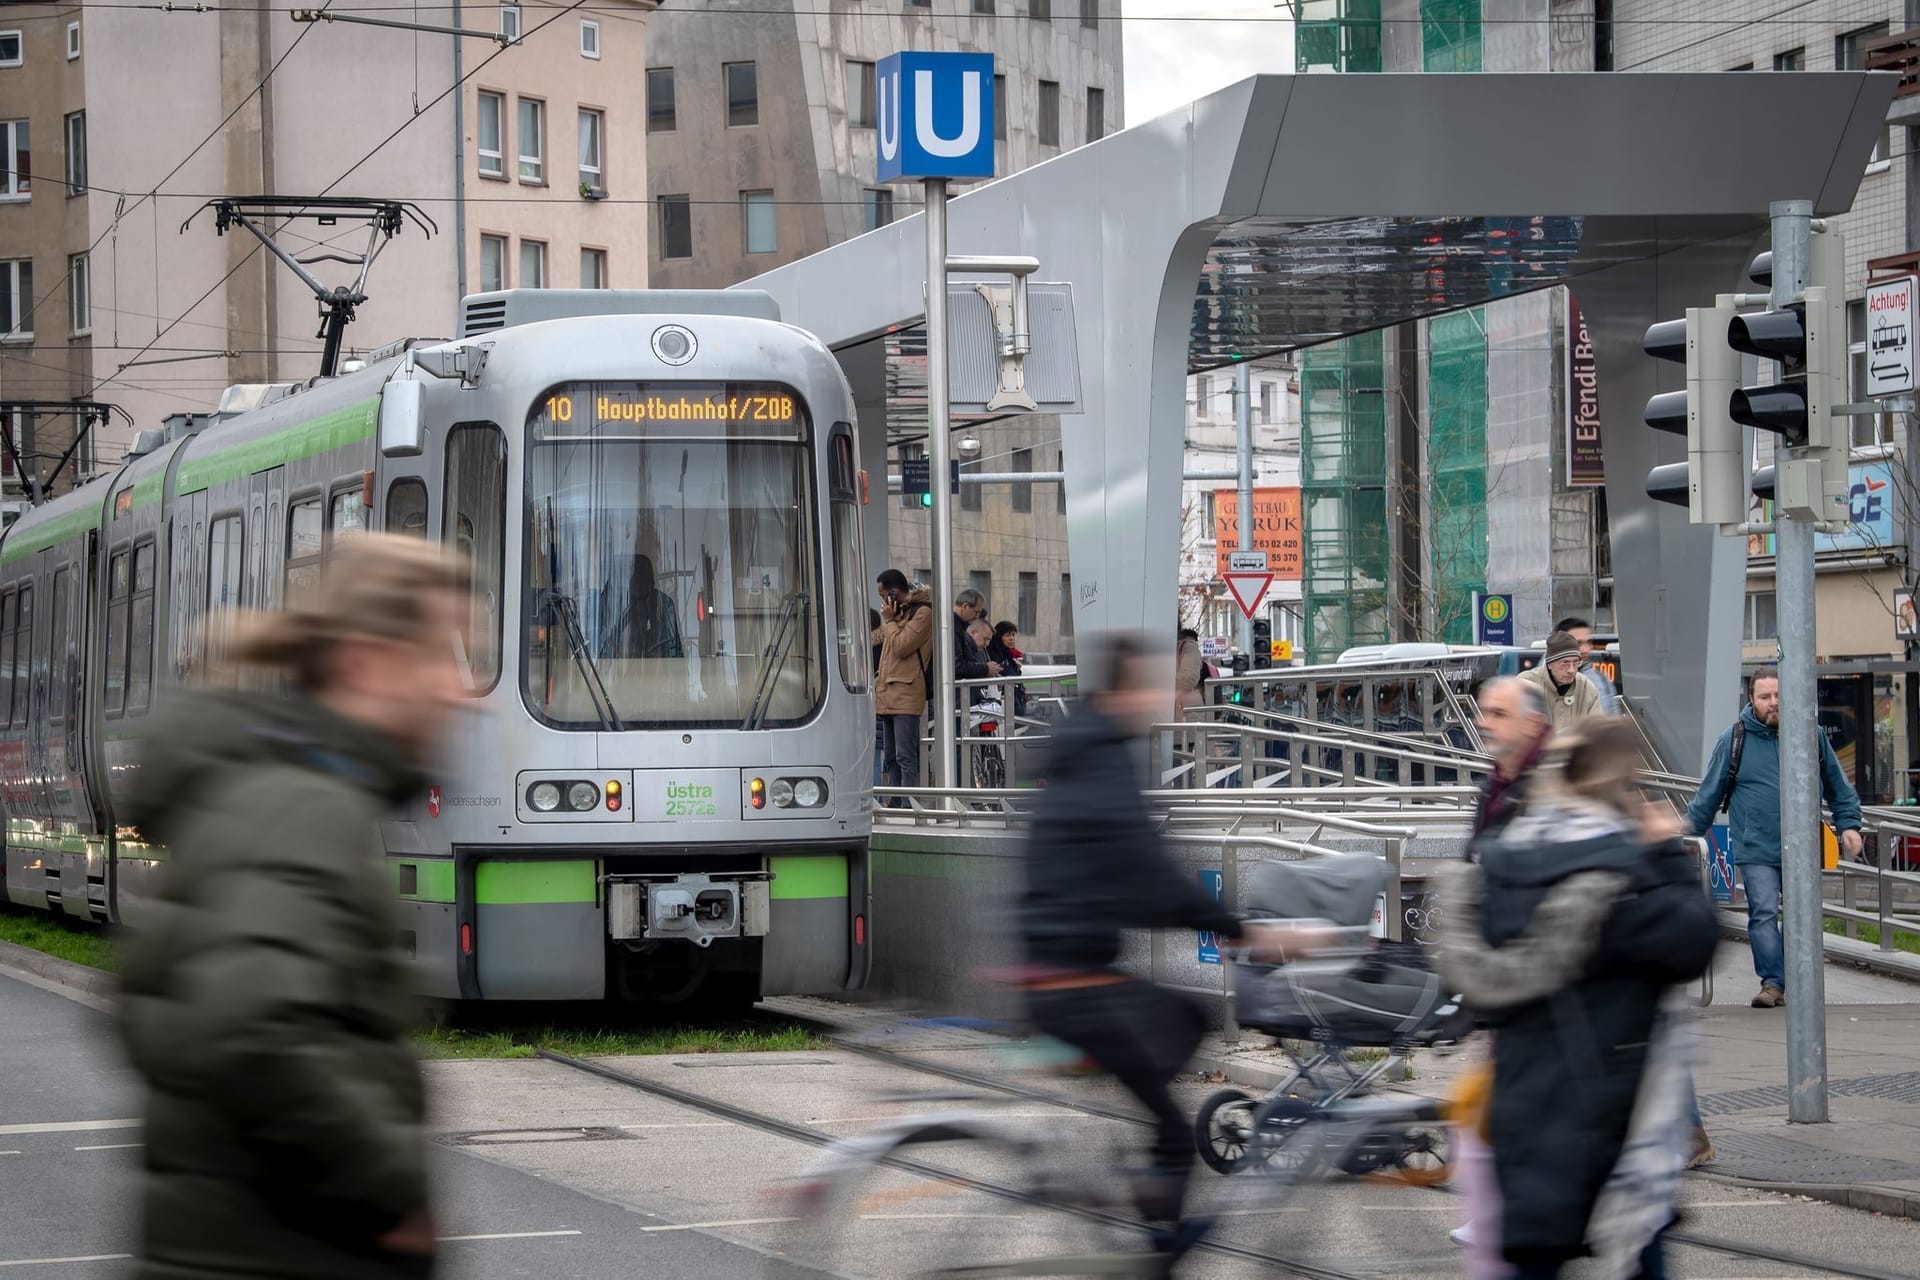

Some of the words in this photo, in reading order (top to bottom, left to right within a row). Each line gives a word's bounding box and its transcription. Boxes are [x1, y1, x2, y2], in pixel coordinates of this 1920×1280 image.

[880, 71, 899, 161] U
[914, 70, 981, 158] U
[1869, 287, 1910, 312] Achtung!
[1574, 311, 1595, 360] Be
[546, 396, 573, 422] 10
[596, 396, 793, 423] Hauptbahnhof/ZOB
[1573, 364, 1601, 441] Efendi
[1223, 502, 1286, 514] GESTBAU
[1260, 540, 1269, 548] 63
[1271, 540, 1281, 548] 02
[1283, 540, 1298, 548] 420
[1283, 554, 1298, 562] 370
[1490, 602, 1501, 617] H
[666, 781, 713, 798] üstra
[666, 801, 716, 816] 2572a
